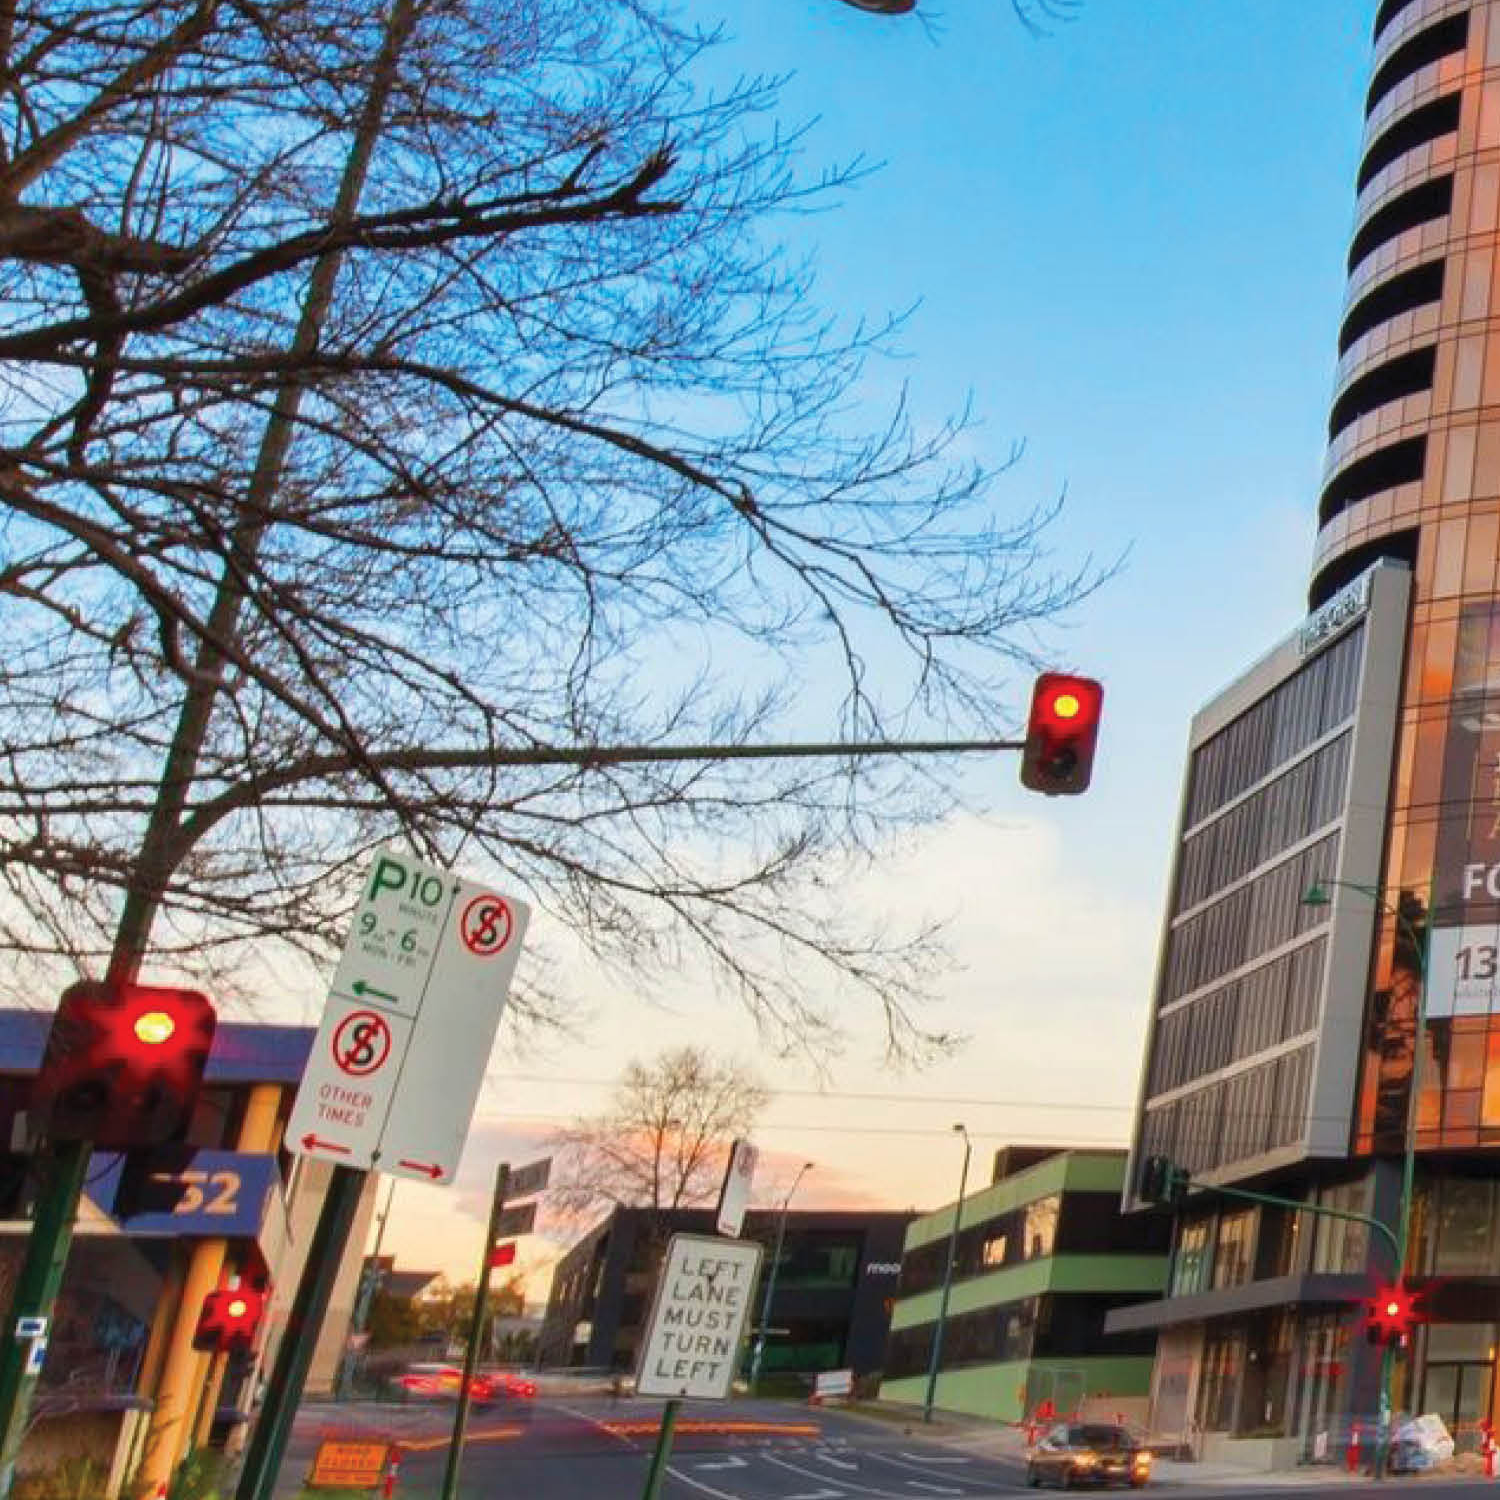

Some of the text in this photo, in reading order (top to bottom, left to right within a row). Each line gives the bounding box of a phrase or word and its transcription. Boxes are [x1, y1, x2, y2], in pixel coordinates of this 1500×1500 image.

[318, 1083, 373, 1108] OTHER
[316, 1104, 366, 1128] TIMES
[680, 1257, 745, 1281] LEFT
[672, 1282, 738, 1306] LANE
[662, 1307, 736, 1331] MUST
[661, 1332, 732, 1357] TURN
[655, 1358, 724, 1382] LEFT
